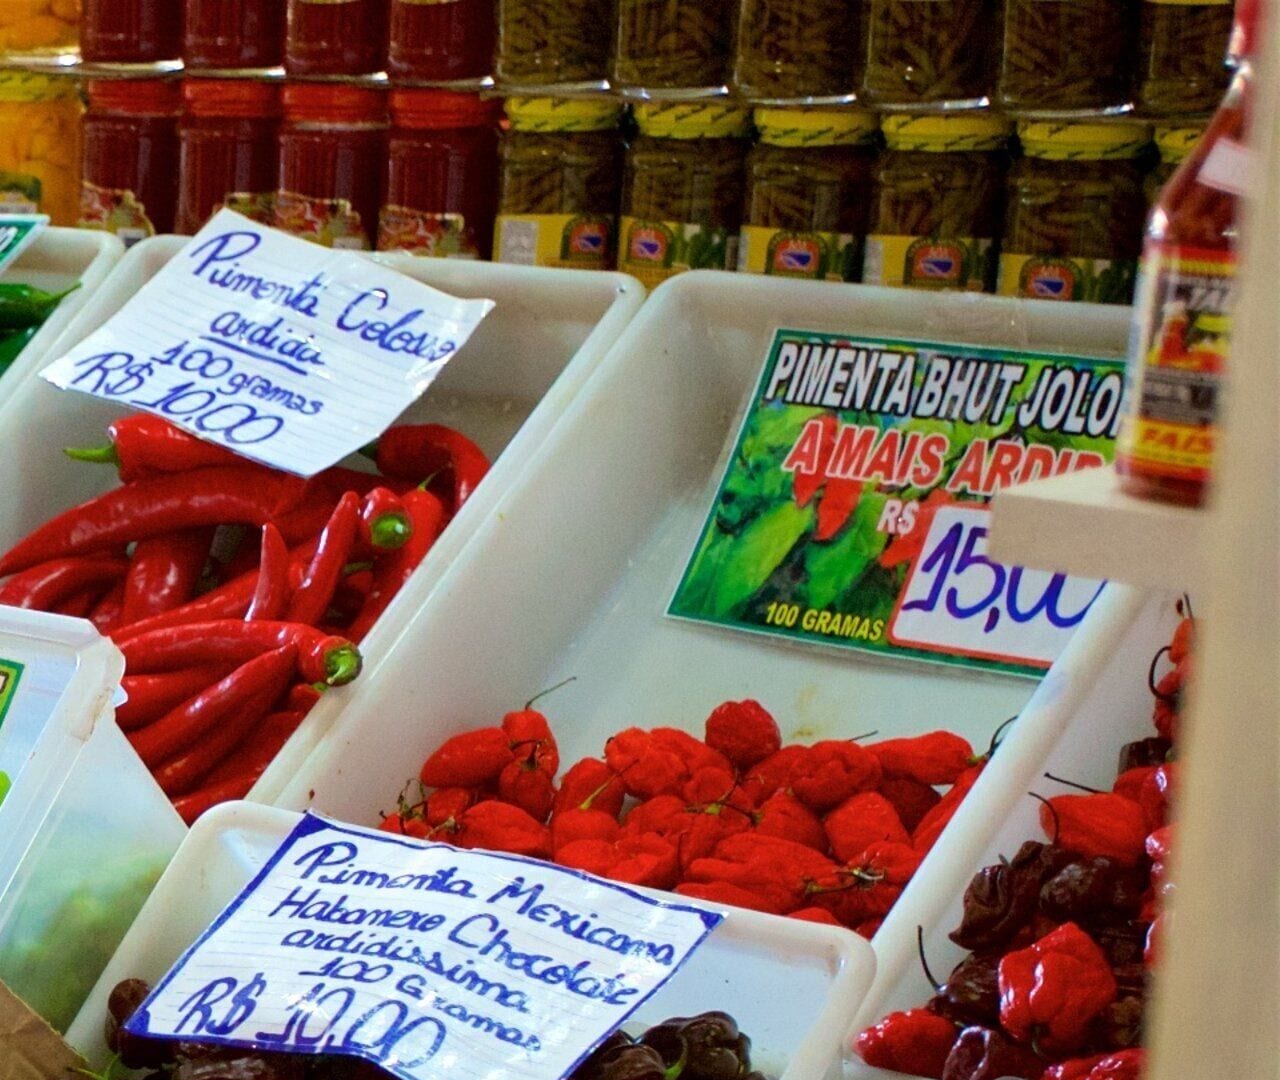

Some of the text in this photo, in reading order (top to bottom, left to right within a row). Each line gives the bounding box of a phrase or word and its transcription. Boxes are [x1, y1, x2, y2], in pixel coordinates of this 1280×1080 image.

[151, 340, 324, 415] 100 gramas
[210, 311, 325, 365] ardida
[71, 351, 284, 444] R$ 10,00
[765, 342, 916, 416] PIMENTA
[915, 359, 1025, 424] BHUT
[1018, 368, 1122, 439] JOLO
[784, 420, 822, 475] A
[828, 426, 948, 489] MAIS
[877, 500, 921, 535] R$
[765, 602, 885, 641] 100 GRAMAS
[269, 886, 639, 1006] Habanero Chocolate
[293, 840, 675, 967] Pimenta Mexicana
[281, 928, 532, 1015] ardidissima
[298, 956, 542, 1052] 100 Gramas
[173, 971, 447, 1070] R$ 10,00
